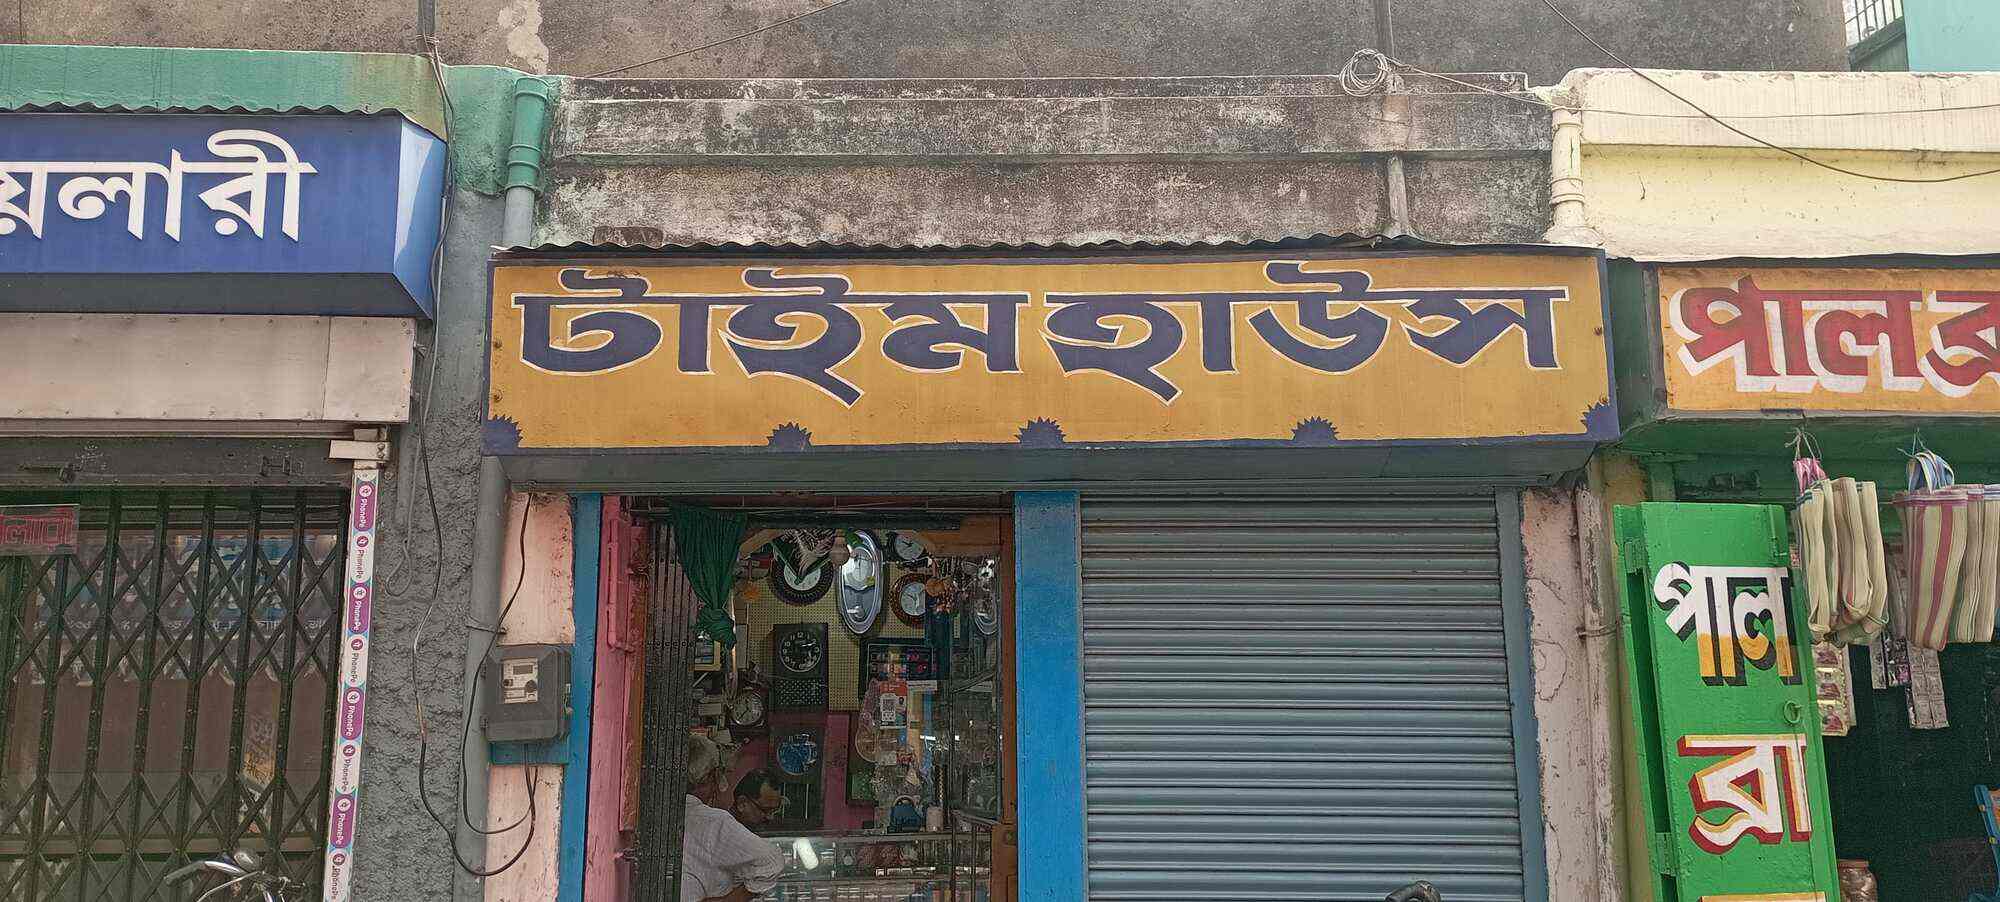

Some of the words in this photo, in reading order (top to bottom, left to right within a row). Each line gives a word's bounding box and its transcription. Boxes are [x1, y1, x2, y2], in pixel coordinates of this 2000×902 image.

[510, 268, 1031, 410] টাইম
[1038, 260, 1569, 407] হাউস
[1669, 274, 1926, 393] পাল
[358, 498, 368, 529] PhonePe
[355, 549, 365, 579] PhonePe
[353, 600, 363, 631] PhonePe
[1654, 561, 1804, 686] পাল
[350, 652, 359, 683] PhonePe
[346, 705, 355, 737] PhonePe
[1677, 734, 1812, 855] ব্রা
